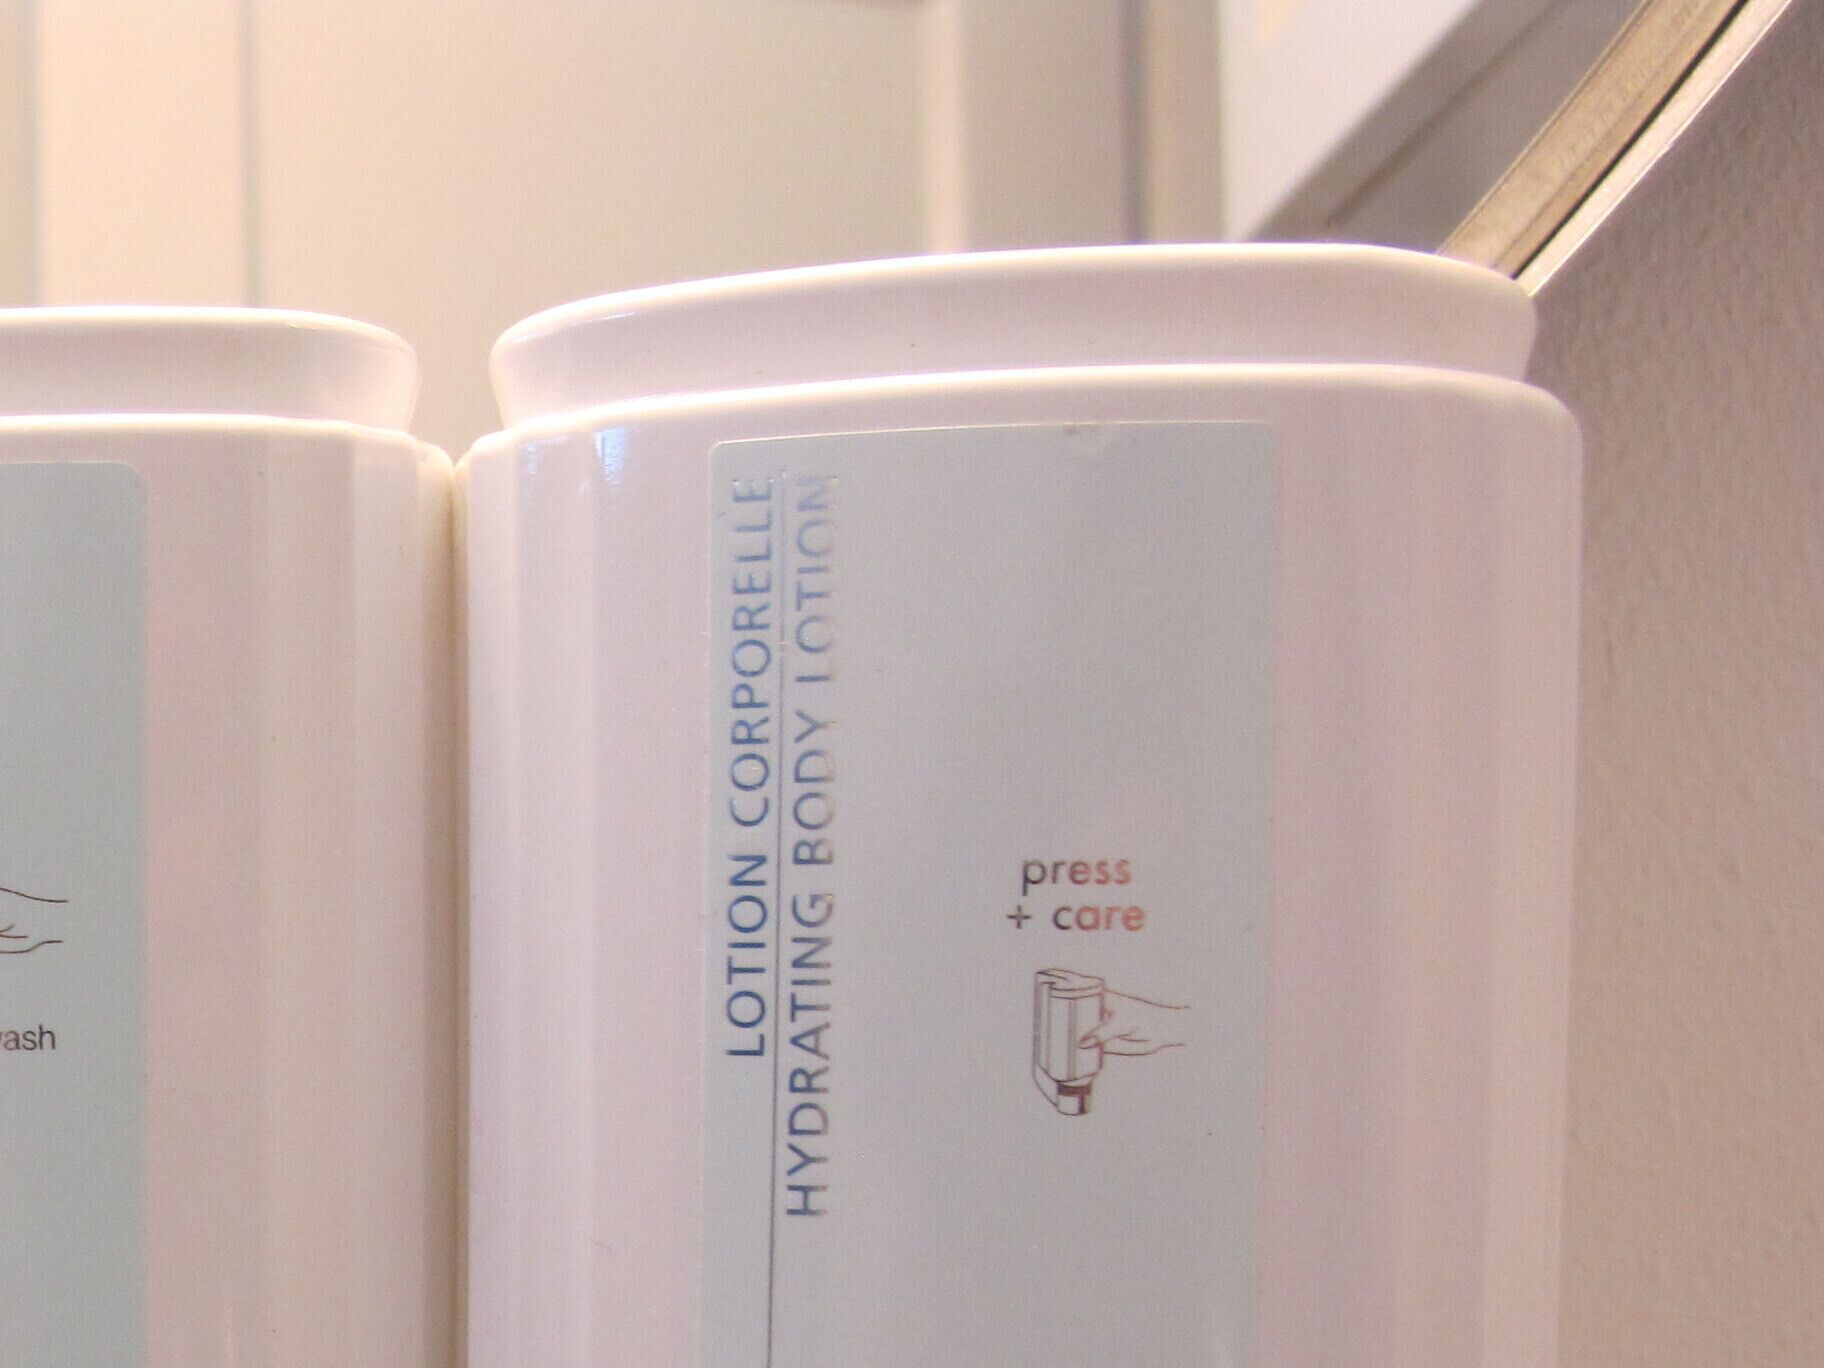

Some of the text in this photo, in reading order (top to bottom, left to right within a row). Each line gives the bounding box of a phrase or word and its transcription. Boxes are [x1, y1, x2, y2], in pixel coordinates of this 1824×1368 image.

[726, 478, 774, 1057] LOTION CORPORELLE
[785, 476, 838, 1216] HYDRATING BODY LOTION
[1021, 856, 1131, 895] press
[1053, 903, 1146, 932] care
